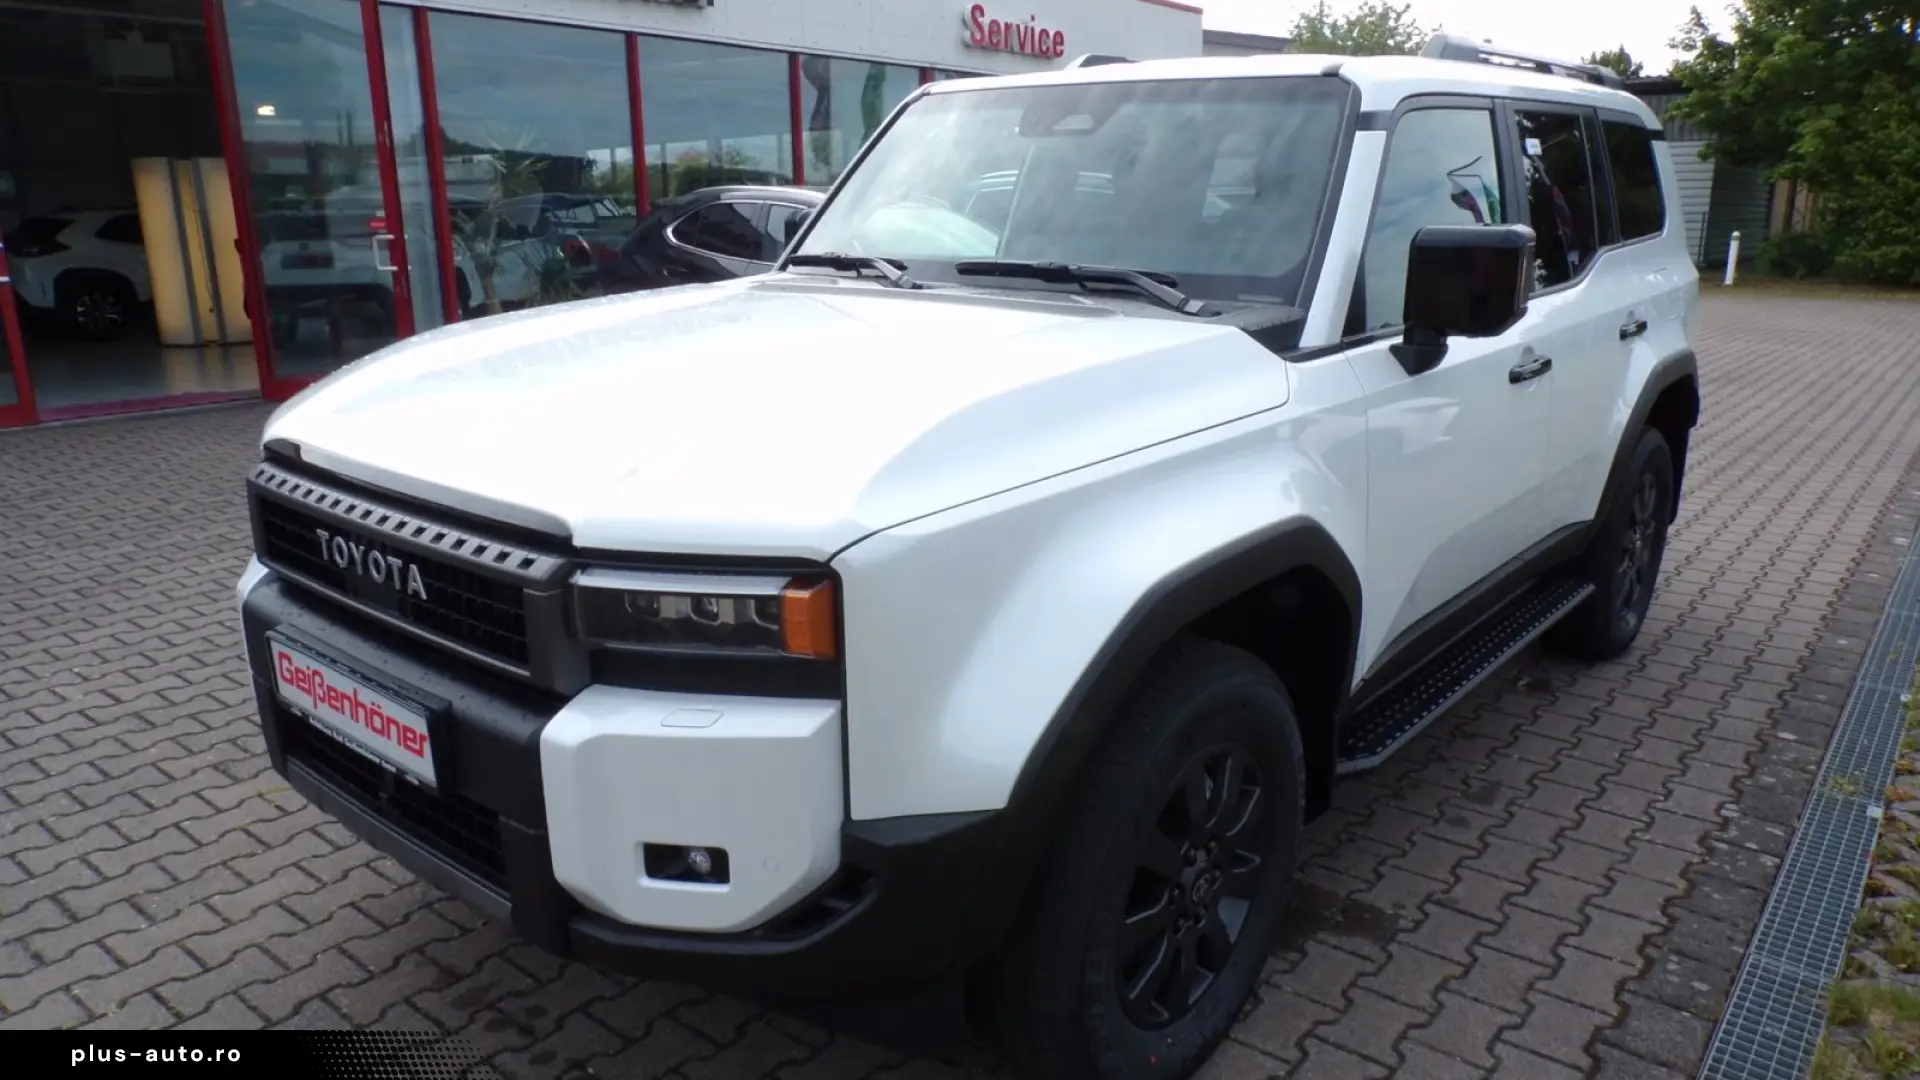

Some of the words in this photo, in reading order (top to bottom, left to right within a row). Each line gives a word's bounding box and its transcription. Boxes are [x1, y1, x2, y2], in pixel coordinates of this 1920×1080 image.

[967, 3, 1065, 58] Service
[316, 528, 427, 600] TOYOTA
[278, 651, 428, 759] Geißenhöner
